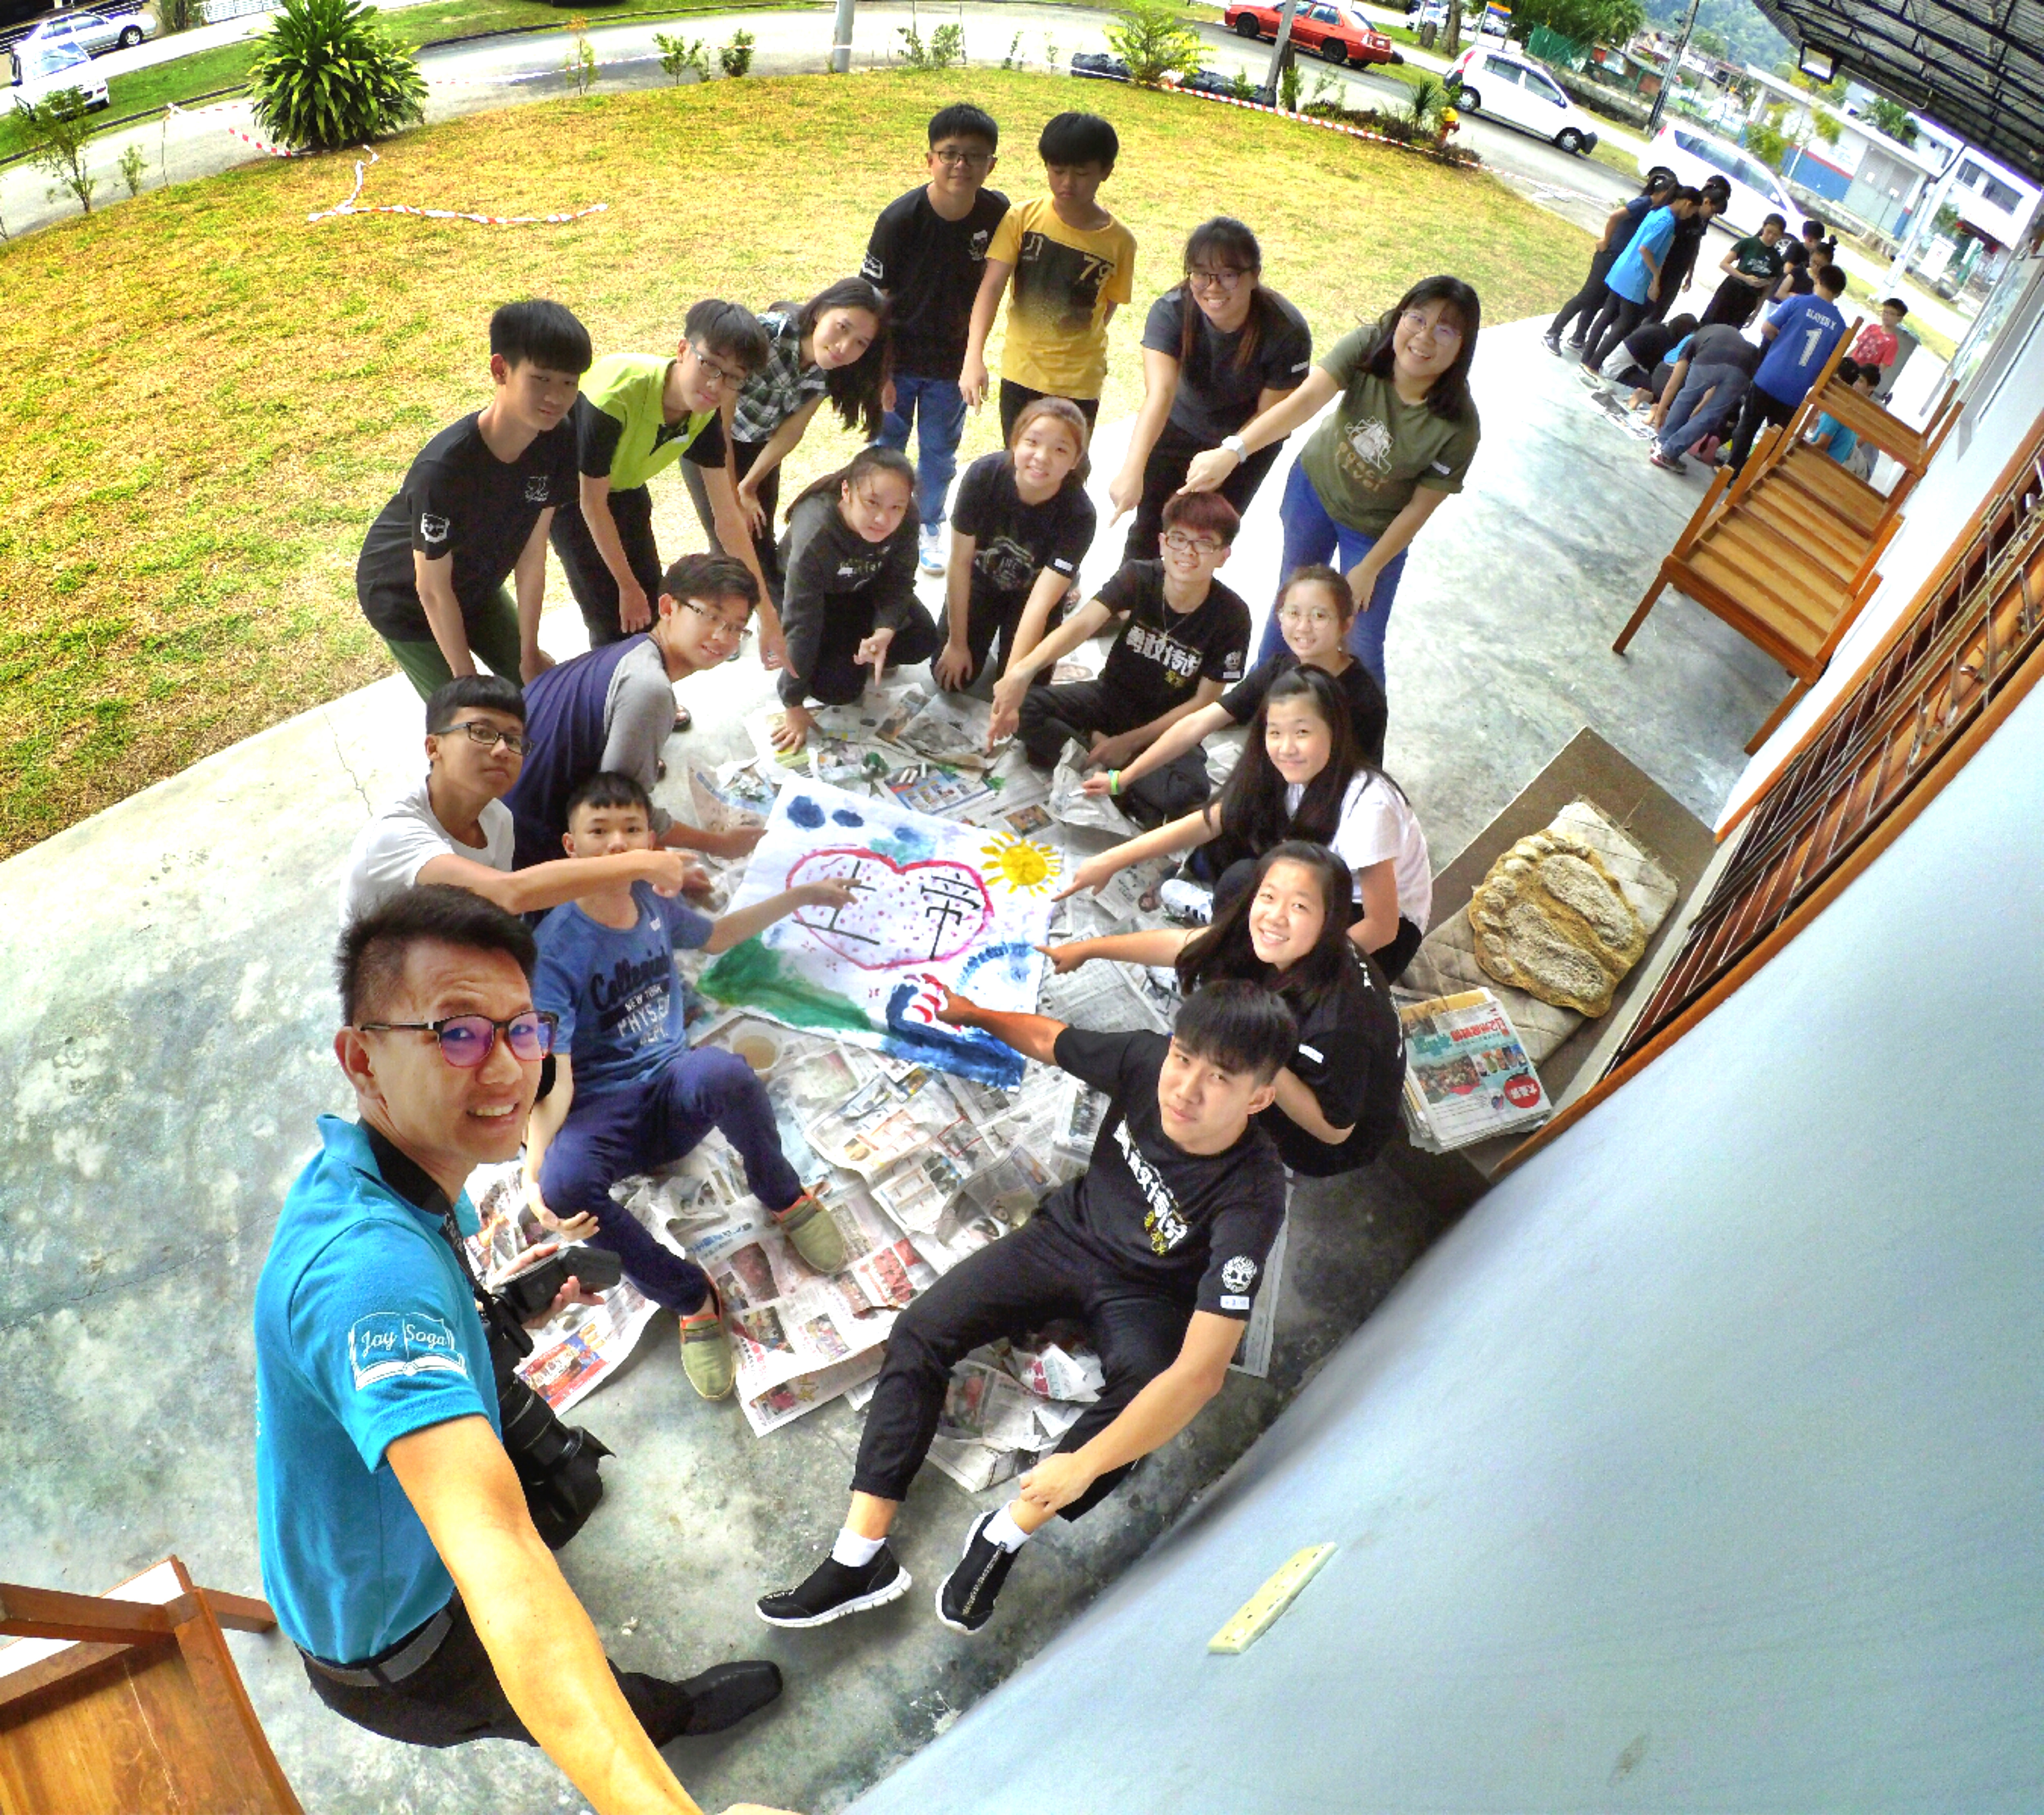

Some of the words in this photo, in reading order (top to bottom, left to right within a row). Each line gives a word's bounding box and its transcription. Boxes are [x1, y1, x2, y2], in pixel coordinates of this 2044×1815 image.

[1078, 254, 1116, 285] 79
[1798, 328, 1823, 367] 1
[625, 994, 643, 1012] NEW
